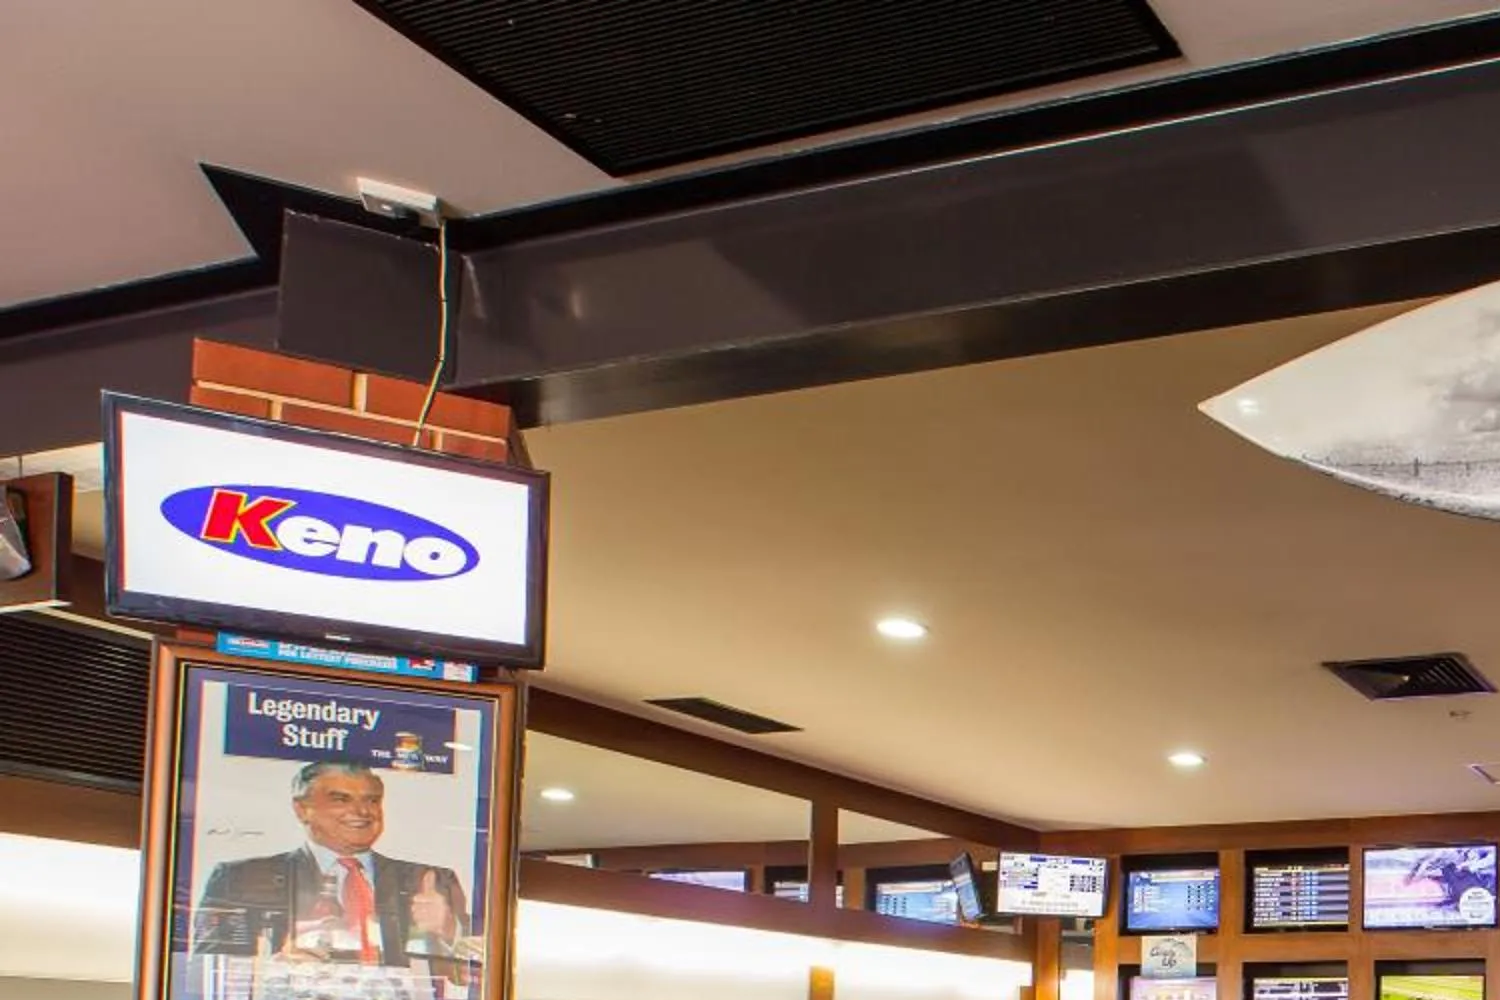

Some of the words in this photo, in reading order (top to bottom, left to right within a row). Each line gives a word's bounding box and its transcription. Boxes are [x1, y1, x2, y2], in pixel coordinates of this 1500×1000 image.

[201, 488, 467, 577] Keno
[248, 693, 380, 731] Legendary
[282, 723, 349, 751] Stuff
